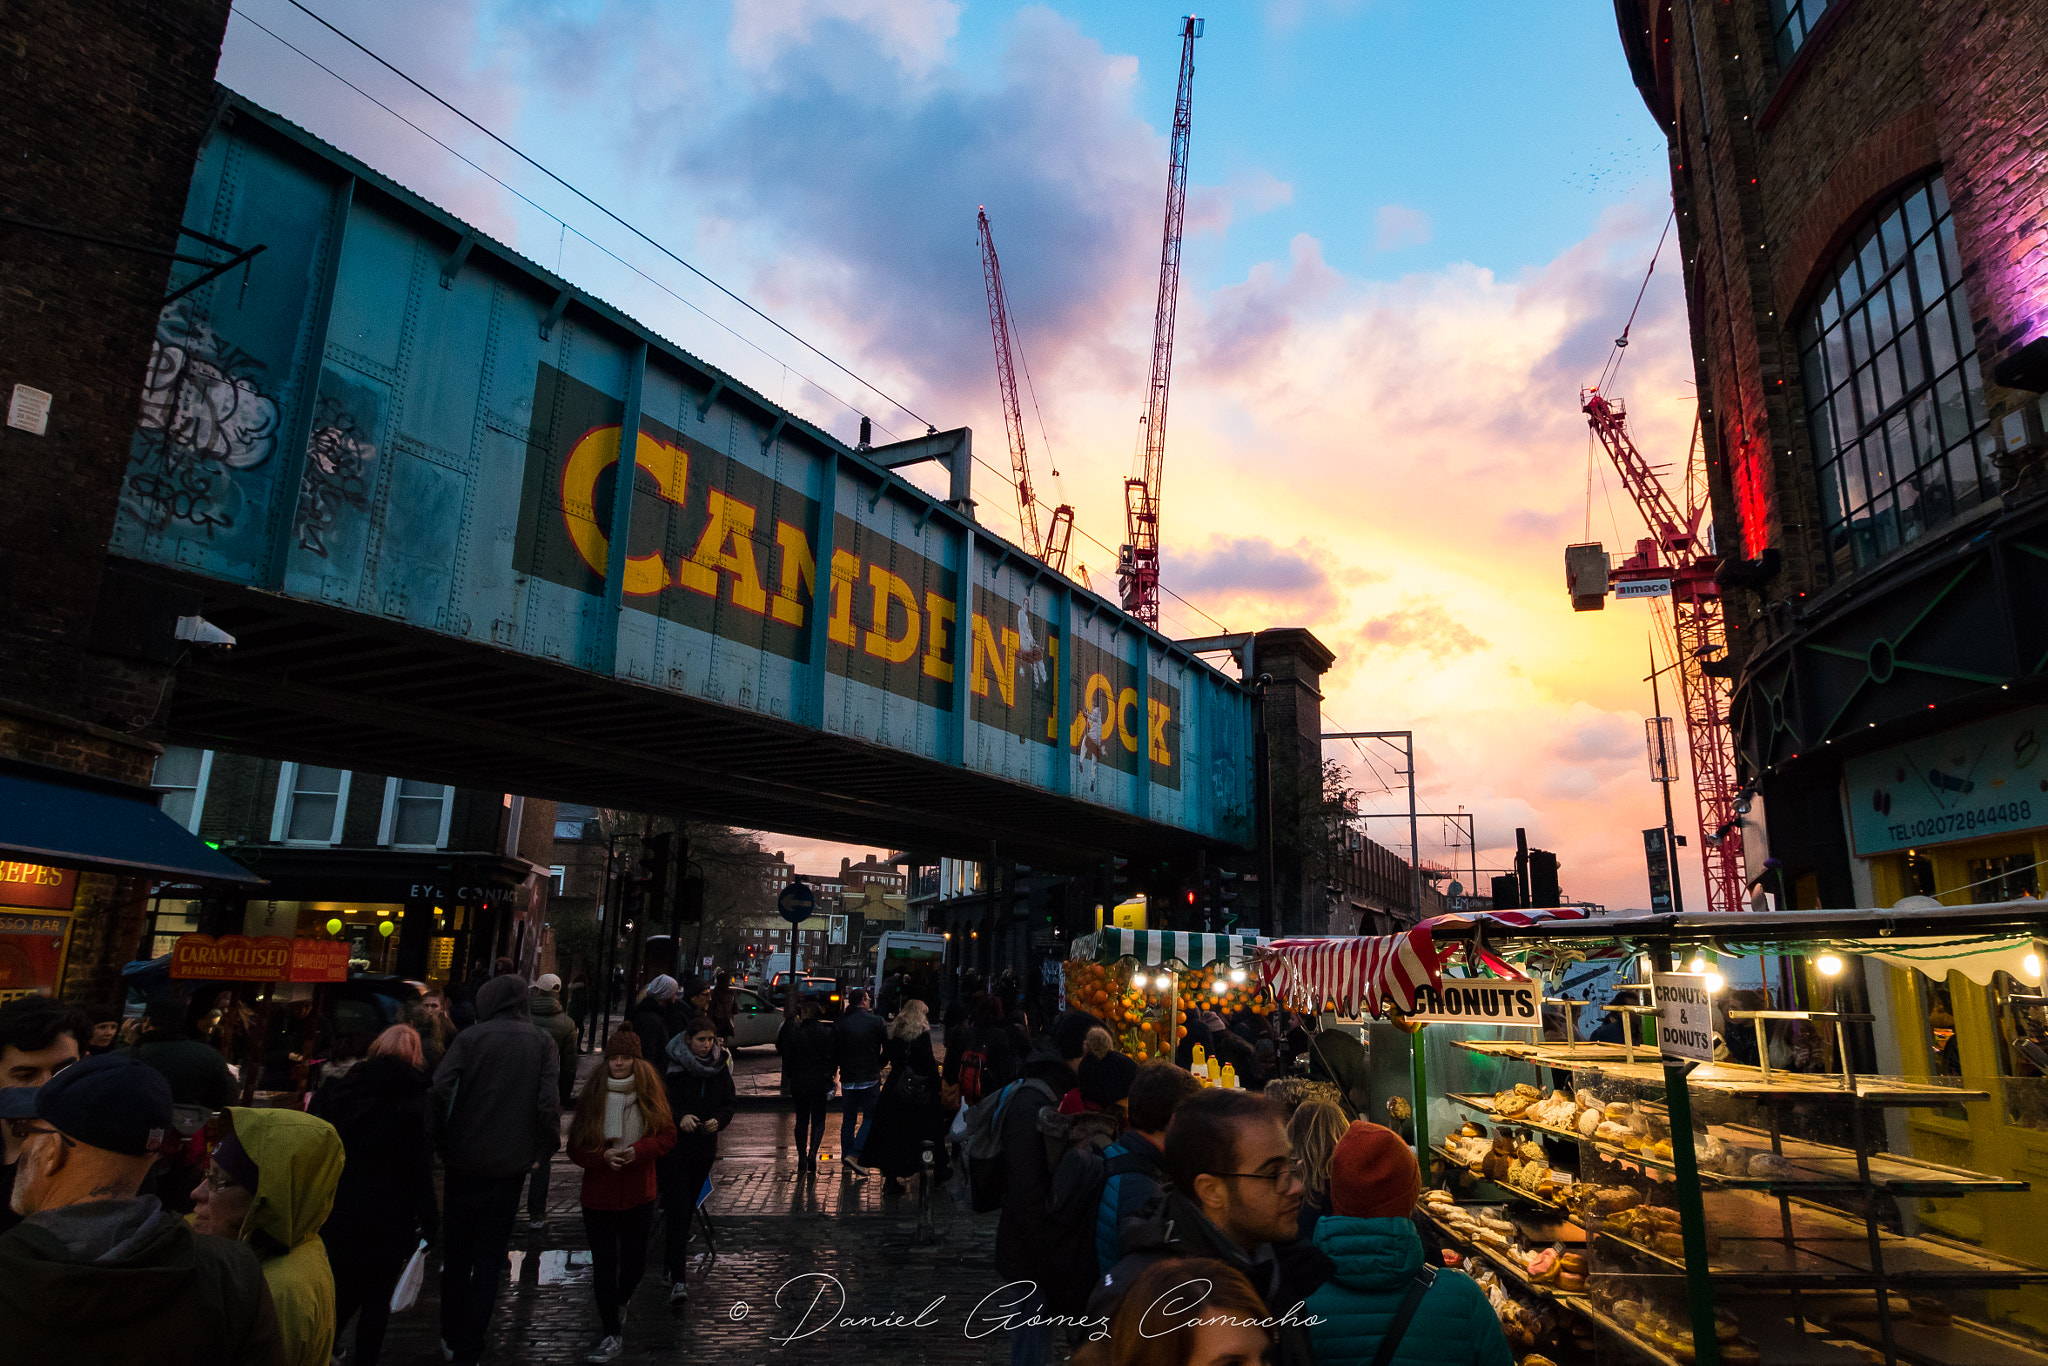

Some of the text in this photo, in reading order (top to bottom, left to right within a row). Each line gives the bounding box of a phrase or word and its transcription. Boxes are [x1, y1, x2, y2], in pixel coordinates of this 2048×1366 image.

[561, 422, 1020, 708] CAMDEN
[1047, 632, 1171, 767] LOCK
[1888, 800, 2031, 841] TEL:02072844488
[410, 884, 444, 898] EYE
[32, 919, 59, 931] BAR
[180, 946, 288, 966] CARAMELISED
[181, 965, 280, 977] PEANUTS ALMONDS
[1655, 985, 1708, 1005] CRONUTS
[1680, 1008, 1688, 1024] &
[1663, 1027, 1708, 1049] DONUTS
